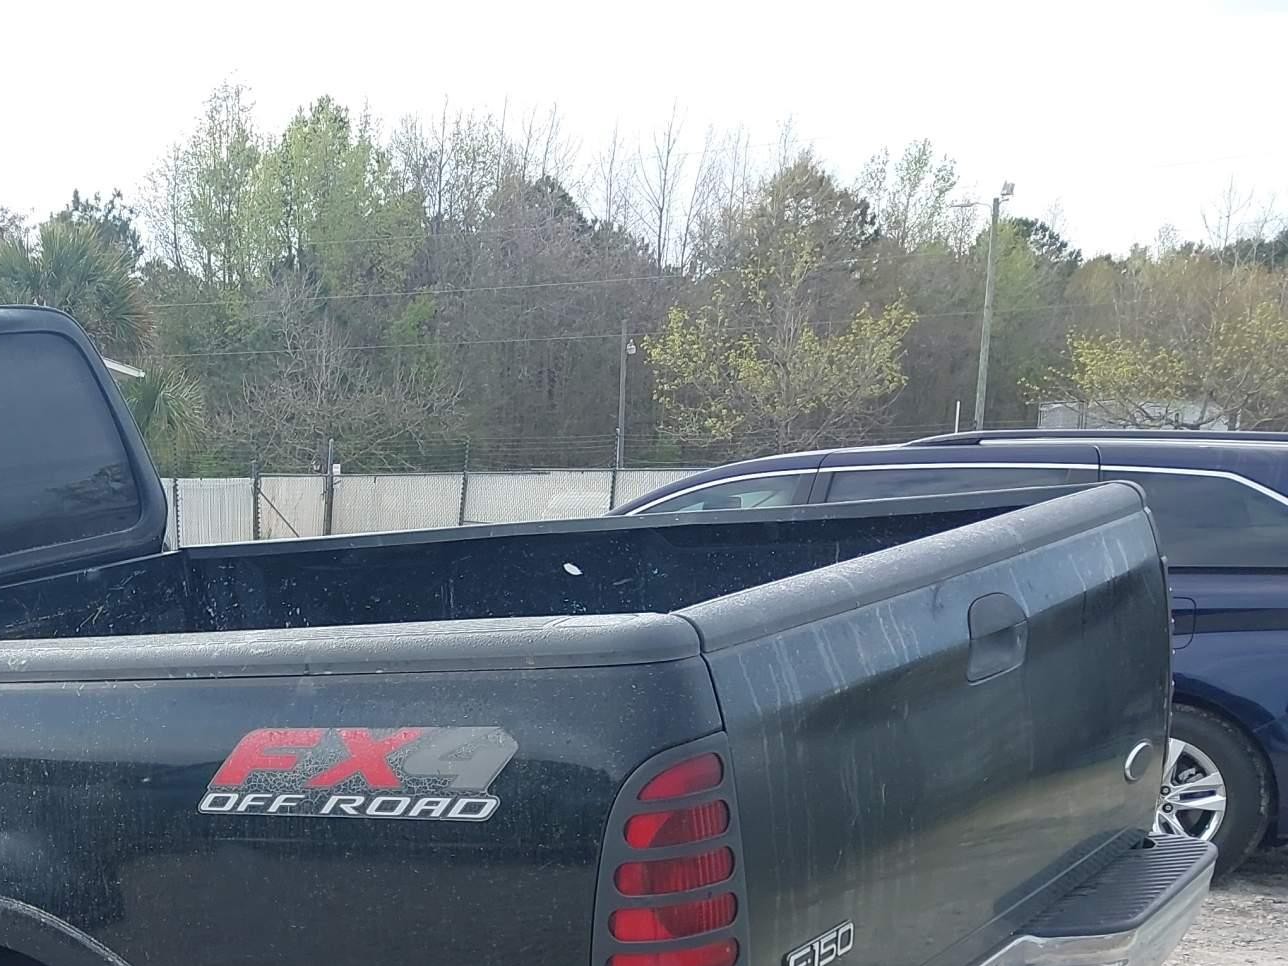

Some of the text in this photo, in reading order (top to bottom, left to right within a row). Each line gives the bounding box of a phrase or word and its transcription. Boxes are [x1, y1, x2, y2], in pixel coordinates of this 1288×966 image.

[212, 727, 518, 790] FX4
[200, 793, 497, 819] OFF ROAD
